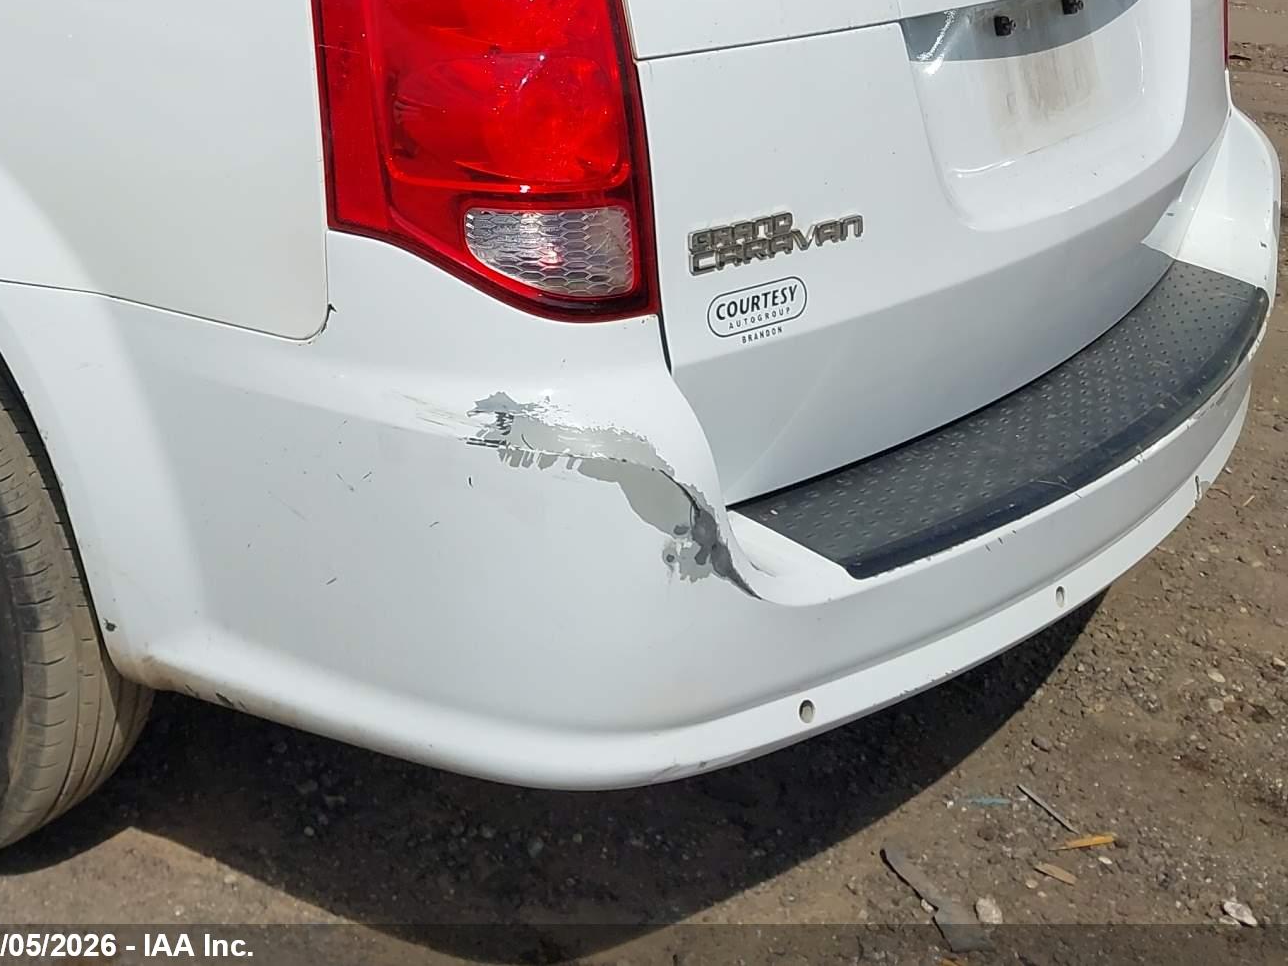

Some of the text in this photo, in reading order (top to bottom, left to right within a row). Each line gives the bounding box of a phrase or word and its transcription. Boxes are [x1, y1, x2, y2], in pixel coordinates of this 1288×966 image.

[688, 212, 793, 253] GRAND
[716, 284, 798, 321] COURTESY
[728, 307, 791, 330] AUTOGROUP
[741, 326, 783, 344] BRANDON
